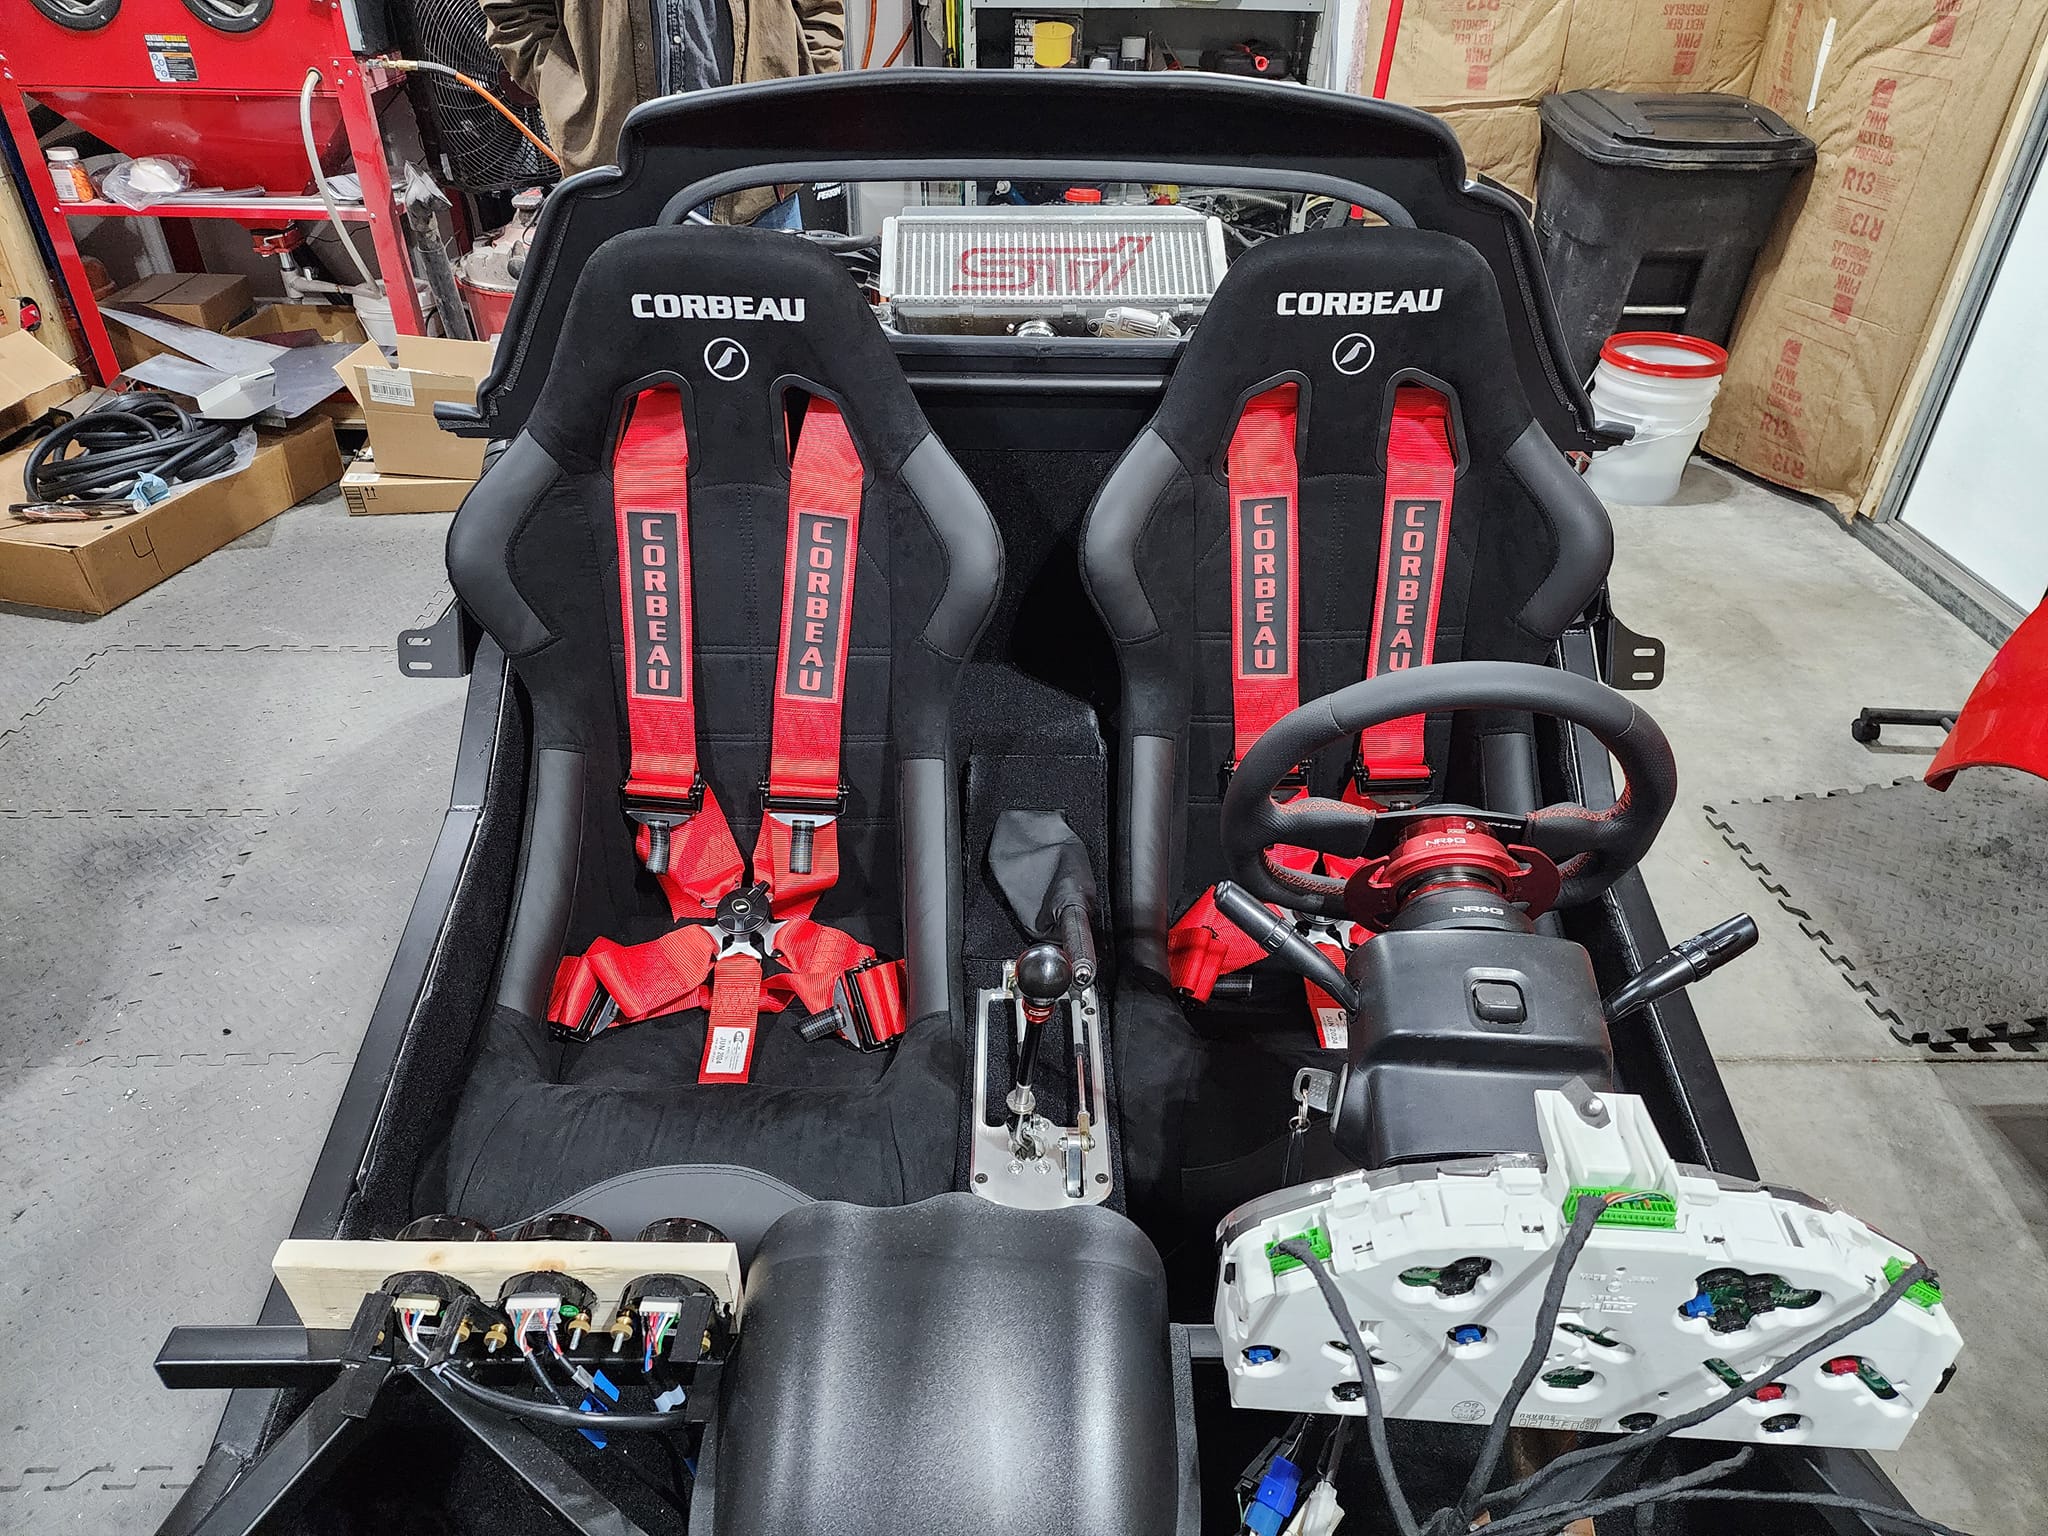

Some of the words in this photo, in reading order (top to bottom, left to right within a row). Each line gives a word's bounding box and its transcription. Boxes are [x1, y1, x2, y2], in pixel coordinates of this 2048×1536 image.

[1663, 3, 1710, 16] FIBERGLAS
[1664, 18, 1684, 30] GEN
[1684, 18, 1706, 30] NEXT
[1674, 32, 1703, 48] PINK
[1464, 47, 1492, 63] PINK
[1862, 109, 1890, 131] PINK
[1856, 130, 1879, 148] NEXT
[1878, 134, 1896, 151] GEN
[1841, 166, 1877, 196] R13
[1849, 211, 1886, 243] R13
[1833, 273, 1863, 297] PINK
[631, 293, 806, 322] CORBEAU
[1277, 288, 1444, 317] CORBEAU
[1774, 363, 1798, 387] PINK
[1760, 410, 1789, 440] R13
[1772, 452, 1806, 481] R13
[128, 525, 165, 575] 4
[1252, 504, 1277, 669] CORBEAU
[1389, 506, 1427, 672] CORBEAU
[641, 518, 672, 691] CORBEAU
[799, 521, 834, 691] CORBEAU
[1451, 905, 1504, 916] NRG
[1326, 1015, 1335, 1027] JUN
[719, 1036, 727, 1051] JUN
